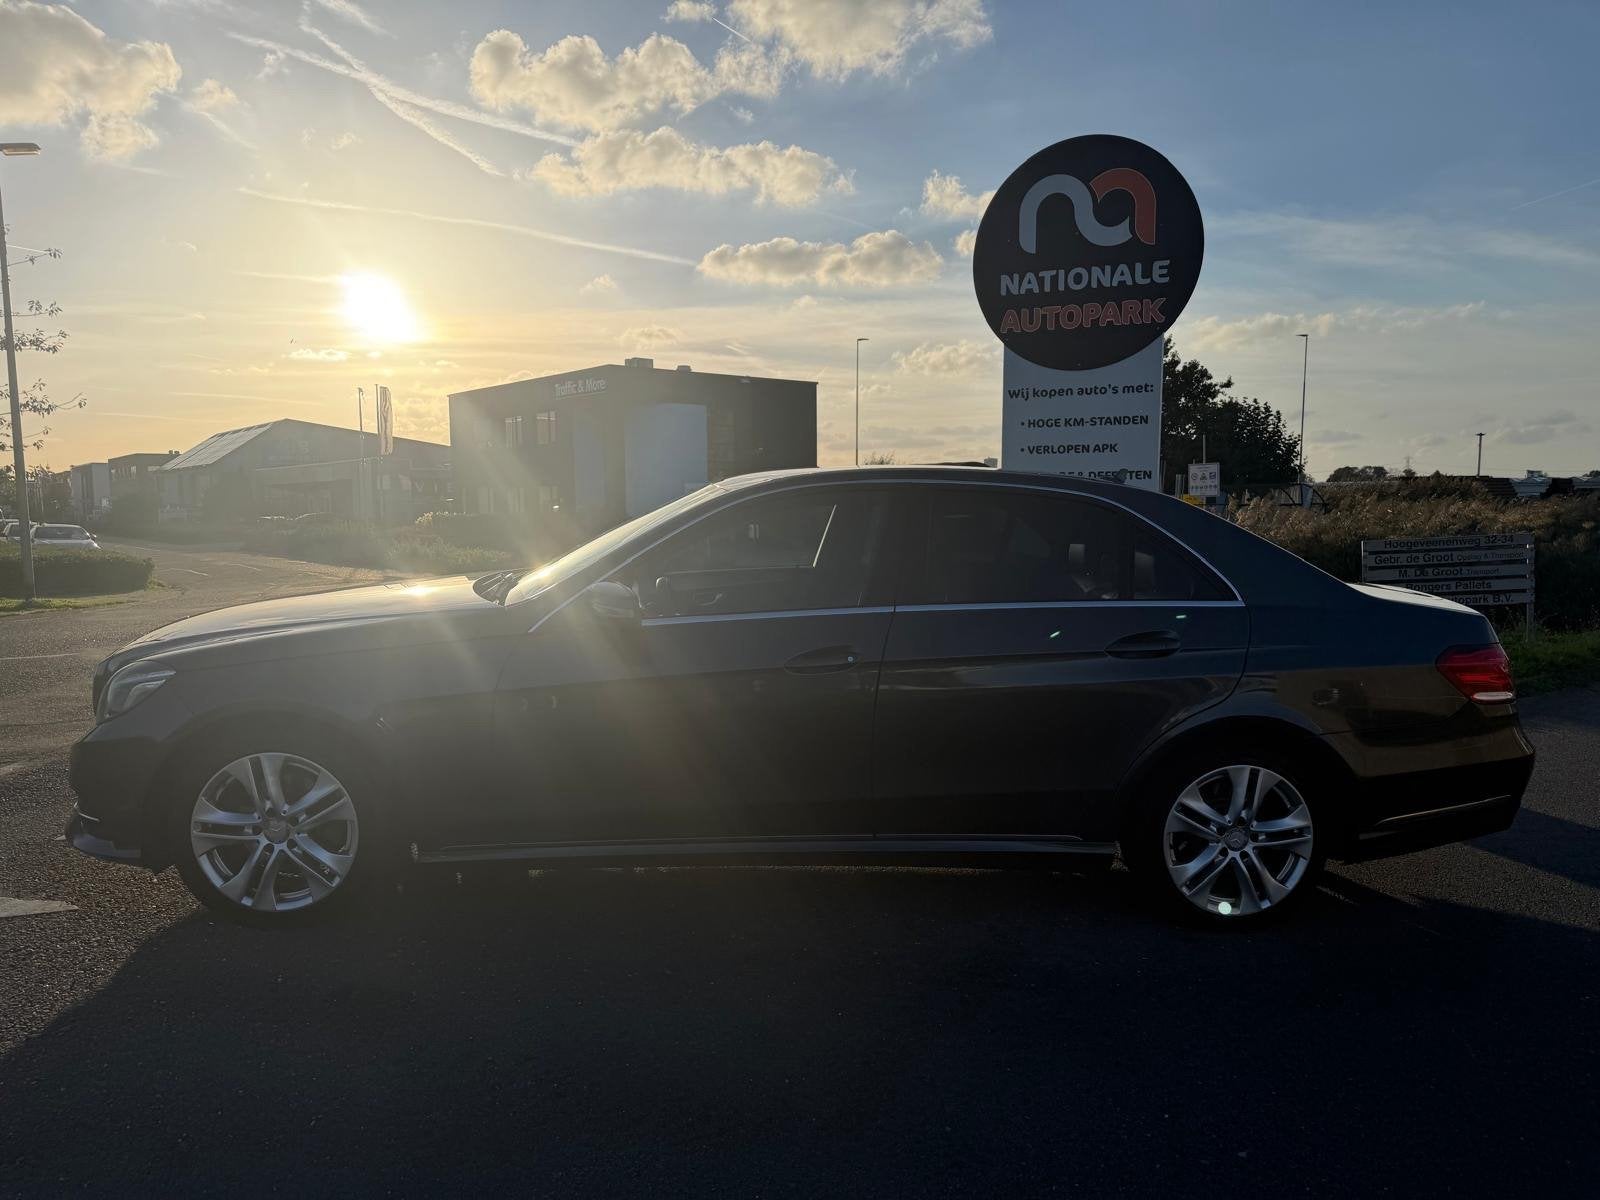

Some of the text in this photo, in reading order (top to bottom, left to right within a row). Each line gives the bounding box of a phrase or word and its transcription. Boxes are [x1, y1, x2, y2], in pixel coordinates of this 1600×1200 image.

[1000, 259, 1170, 296] NATIONALE
[1001, 298, 1167, 334] AUTOPARK
[554, 377, 607, 396] Traffic & More
[1008, 383, 1154, 401] Wij kopen auto's met:
[1027, 415, 1149, 429] HOGE KM-STANDEN
[1027, 443, 1119, 455] VERLOPEN APK
[1088, 470, 1153, 481] DEFETEN
[1484, 534, 1514, 545] 32-34
[1374, 554, 1403, 565] Gebr.
[1406, 553, 1421, 564] de
[1422, 552, 1454, 563] Groot
[1398, 569, 1410, 578] M.
[1414, 568, 1429, 578] De
[1431, 567, 1464, 577] Groot
[1455, 581, 1492, 590] Pallets
[1493, 593, 1514, 603] B.V.
